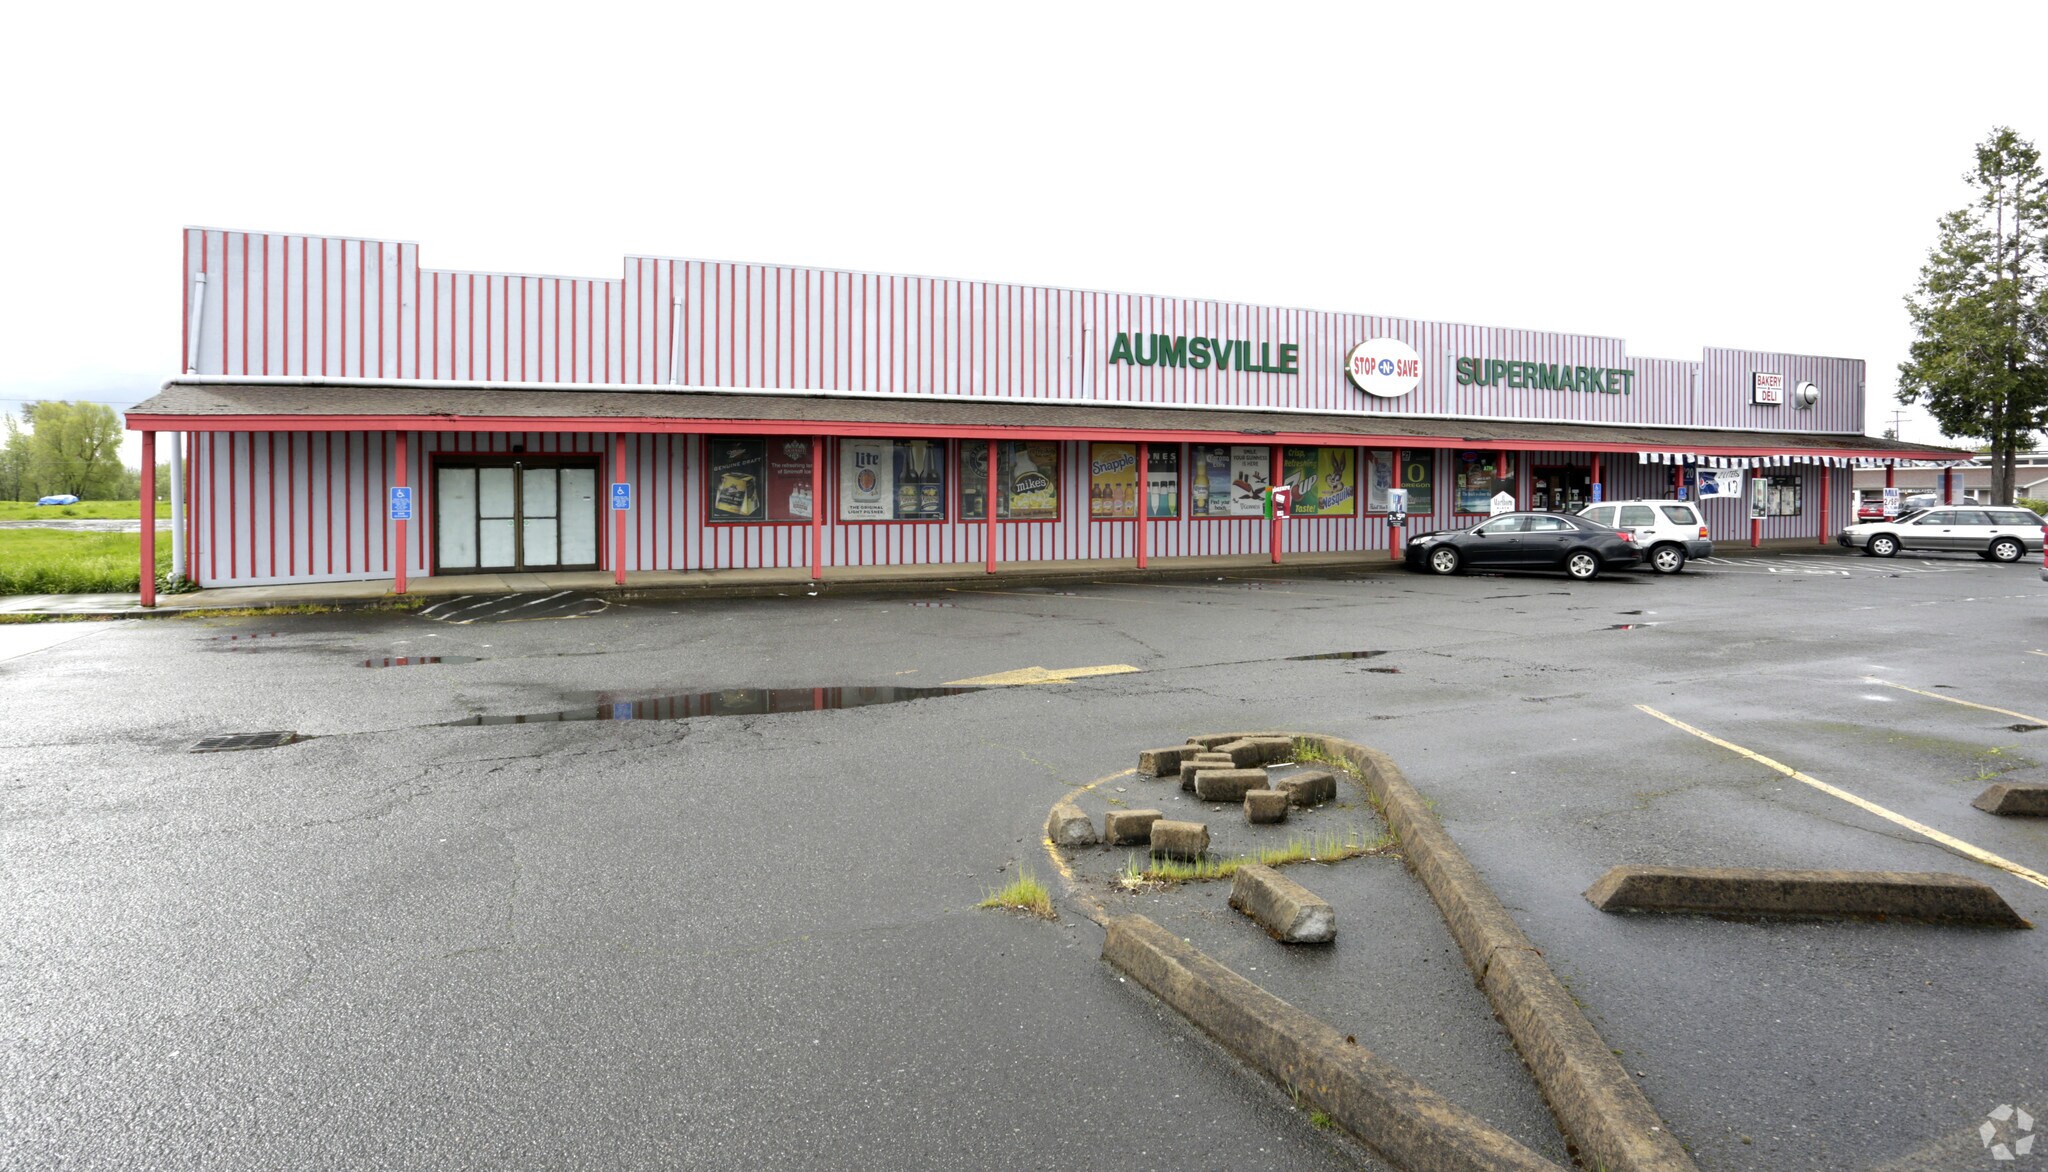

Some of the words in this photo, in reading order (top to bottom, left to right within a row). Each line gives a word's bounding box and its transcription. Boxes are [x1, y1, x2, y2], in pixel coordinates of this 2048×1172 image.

[1108, 331, 1299, 376] AUMSVILLE
[1353, 357, 1376, 376] STOP
[1396, 358, 1419, 378] SAVE
[1457, 356, 1634, 395] SUPERMARKET
[1757, 375, 1782, 388] BAKERY
[1761, 390, 1777, 402] DELI
[713, 462, 741, 472] GENUINE
[742, 457, 761, 466] DRAFT
[856, 452, 879, 468] Lite
[1092, 454, 1134, 475] Snapple
[1016, 478, 1047, 493] mike's
